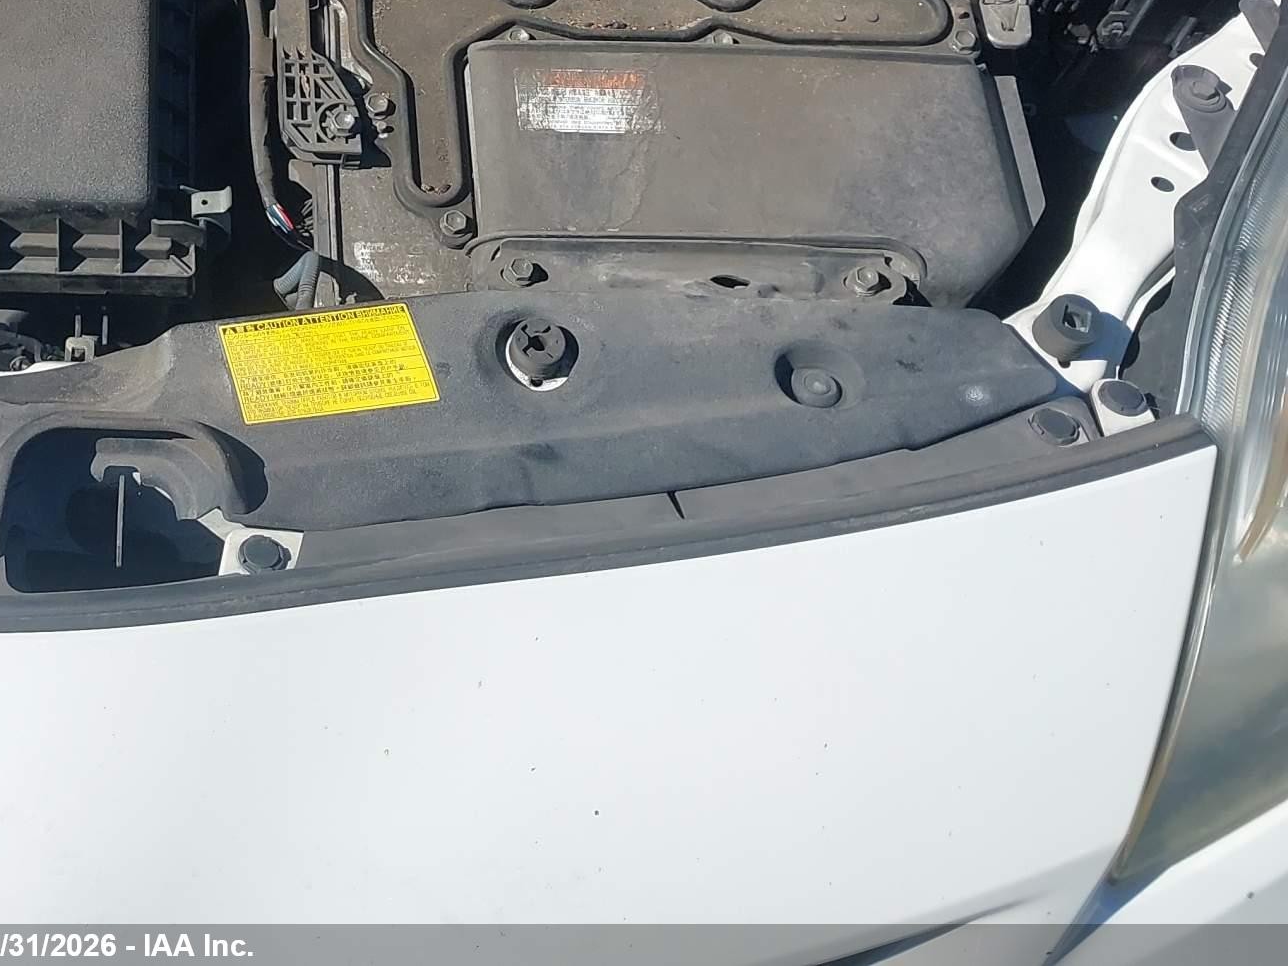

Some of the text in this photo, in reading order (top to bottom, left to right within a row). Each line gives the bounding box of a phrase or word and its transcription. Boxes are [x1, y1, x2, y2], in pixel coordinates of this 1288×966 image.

[257, 318, 299, 331] CAUTION
[302, 312, 353, 325] ATTENTION
[356, 305, 404, 319] ВНИМАНИЕ
